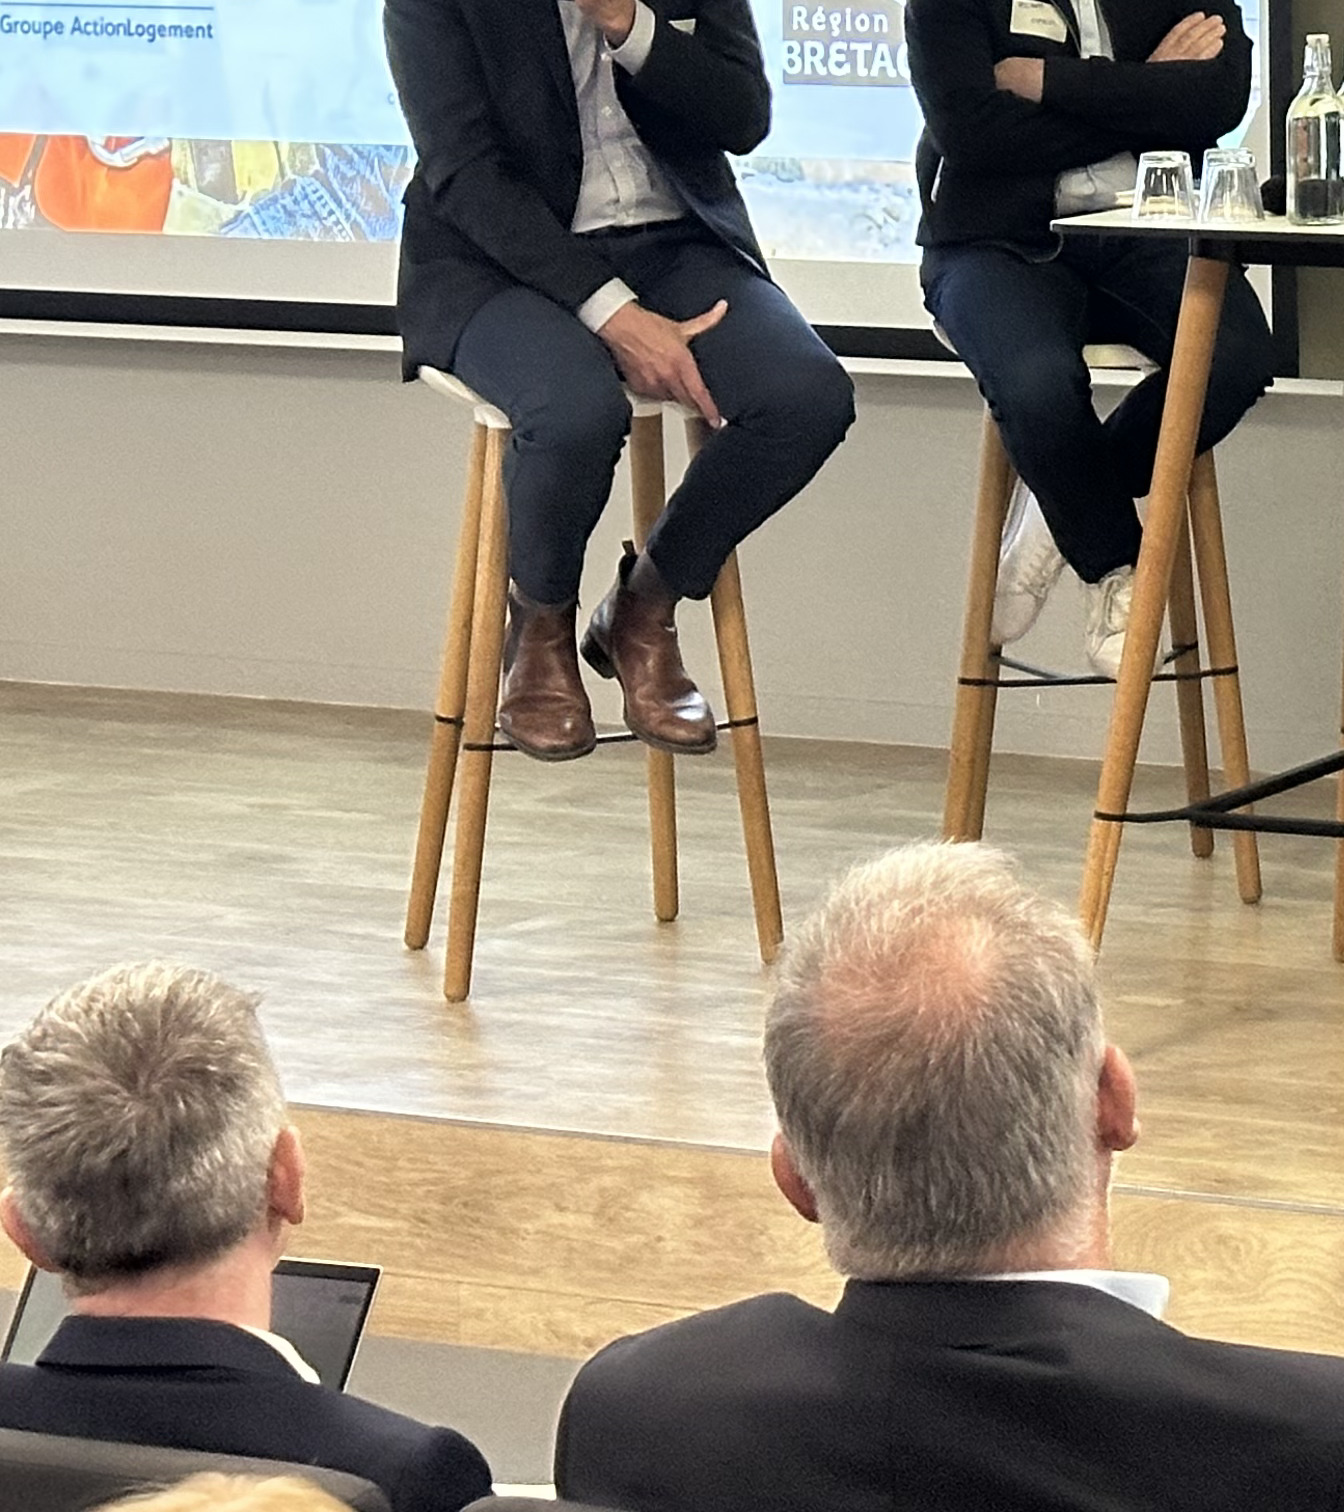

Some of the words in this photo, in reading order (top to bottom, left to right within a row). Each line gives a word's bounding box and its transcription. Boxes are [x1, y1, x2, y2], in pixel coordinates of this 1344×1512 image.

[0, 15, 65, 39] Groupe
[70, 16, 214, 42] ActionLogement
[792, 5, 889, 37] Région
